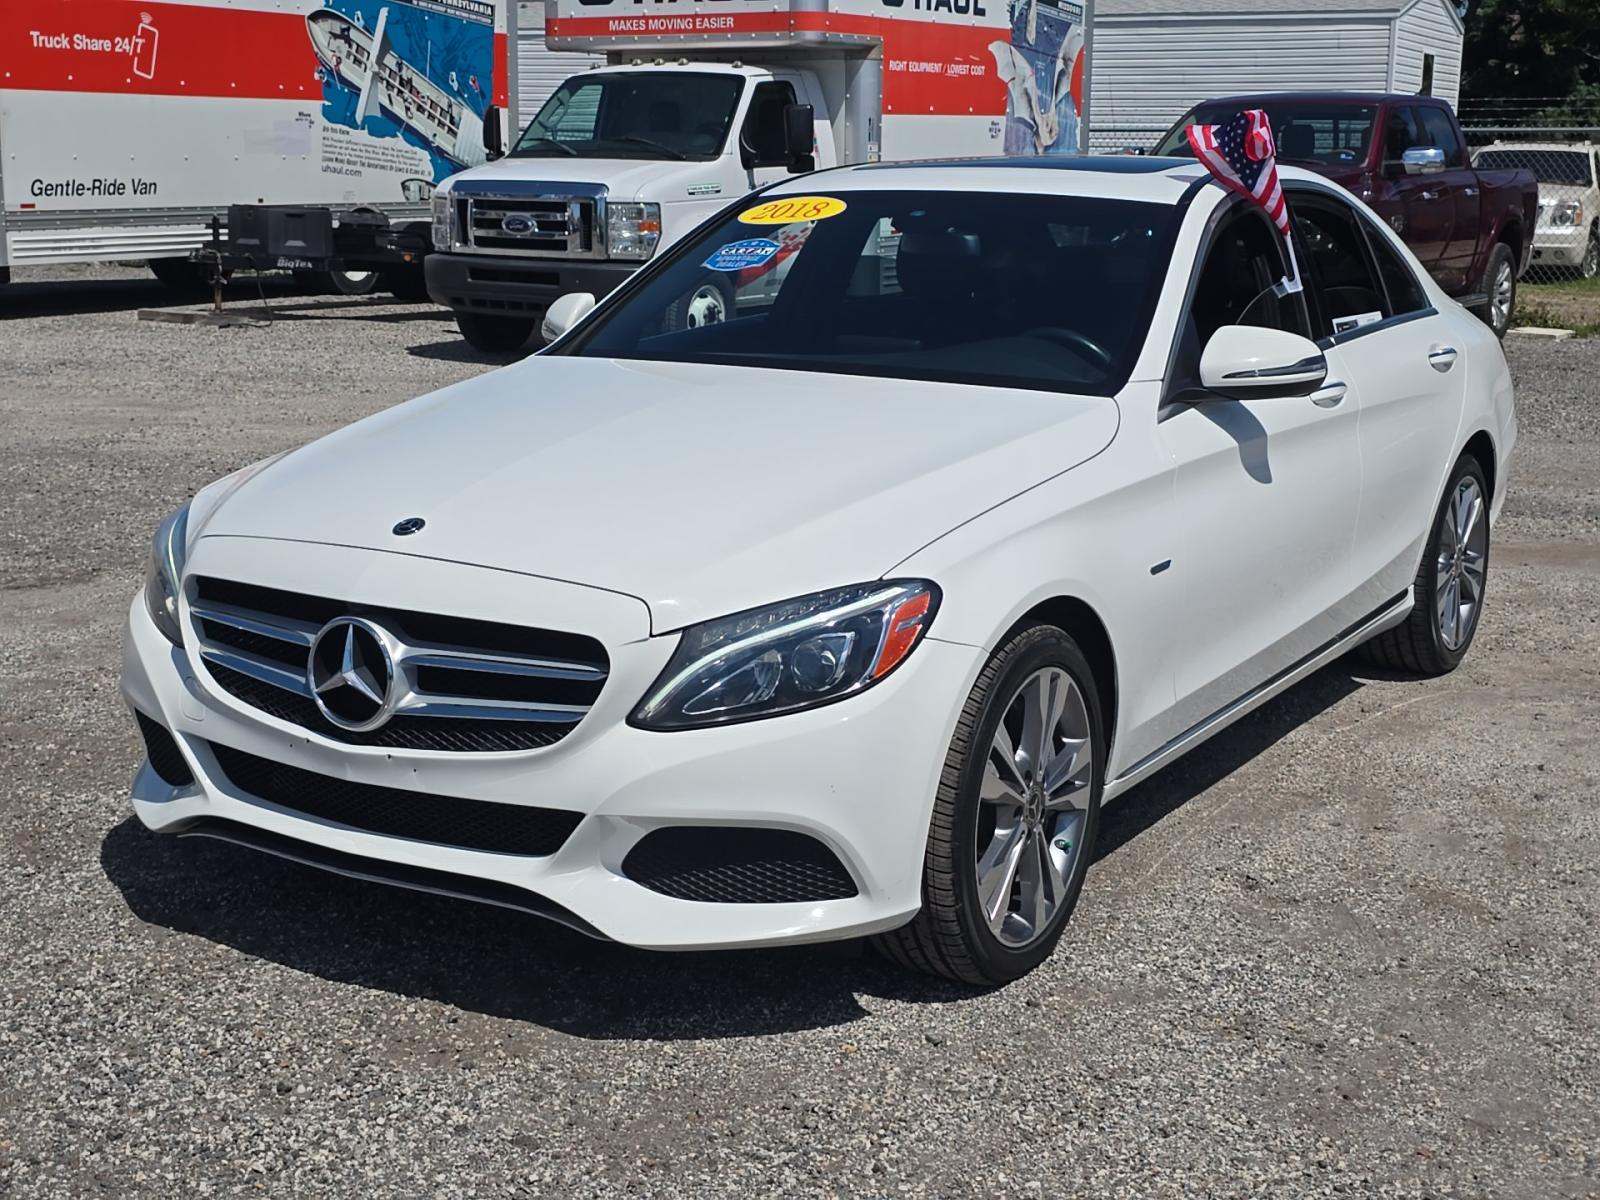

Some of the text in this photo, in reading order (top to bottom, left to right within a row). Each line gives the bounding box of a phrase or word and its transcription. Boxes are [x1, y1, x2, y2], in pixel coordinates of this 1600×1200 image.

[609, 17, 734, 31] MAKES MOVING EASIER
[29, 31, 71, 49] Truck
[73, 34, 112, 52] Share
[889, 60, 908, 72] RIGHT
[909, 61, 943, 73] EQUIPMENT
[947, 64, 970, 75] LOWEST
[970, 65, 985, 76] COST
[321, 164, 363, 178] uhaul.com
[30, 178, 158, 197] Gentle-Ride Van
[750, 201, 830, 221] 2018
